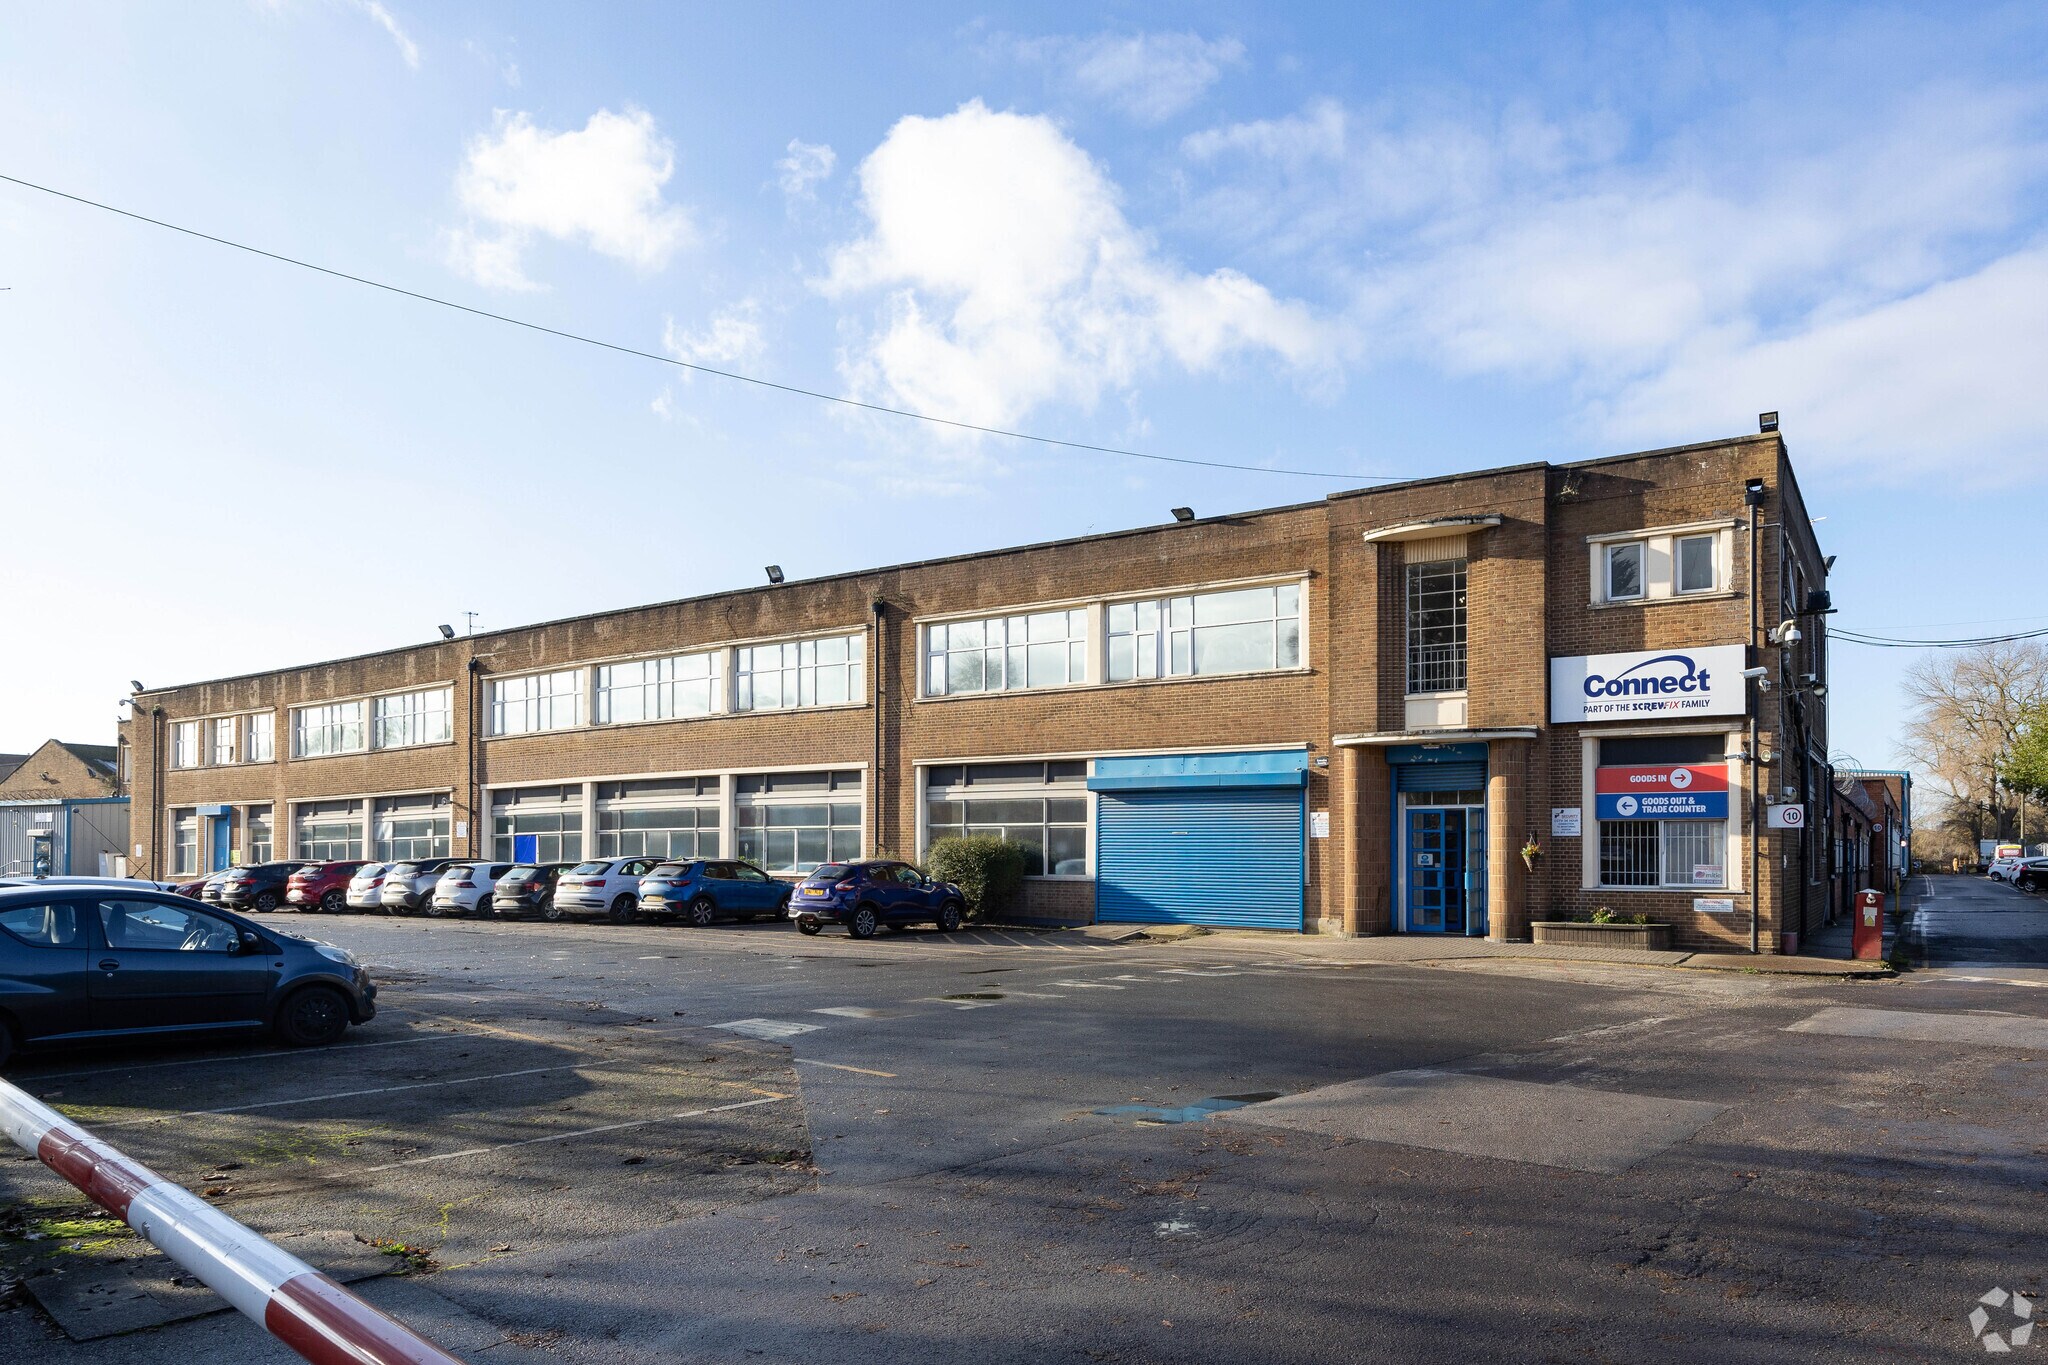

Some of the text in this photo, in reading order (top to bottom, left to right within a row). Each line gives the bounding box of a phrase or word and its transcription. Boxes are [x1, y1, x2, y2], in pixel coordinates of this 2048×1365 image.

[1584, 667, 1711, 698] Connect
[1583, 699, 1711, 713] PART OF THE SCREWFIX FAMILY
[1629, 774, 1667, 783] GOODS IN
[1641, 796, 1696, 805] GOODS OUT &
[1641, 804, 1707, 813] TRADE COUNTER
[1786, 811, 1798, 821] 10
